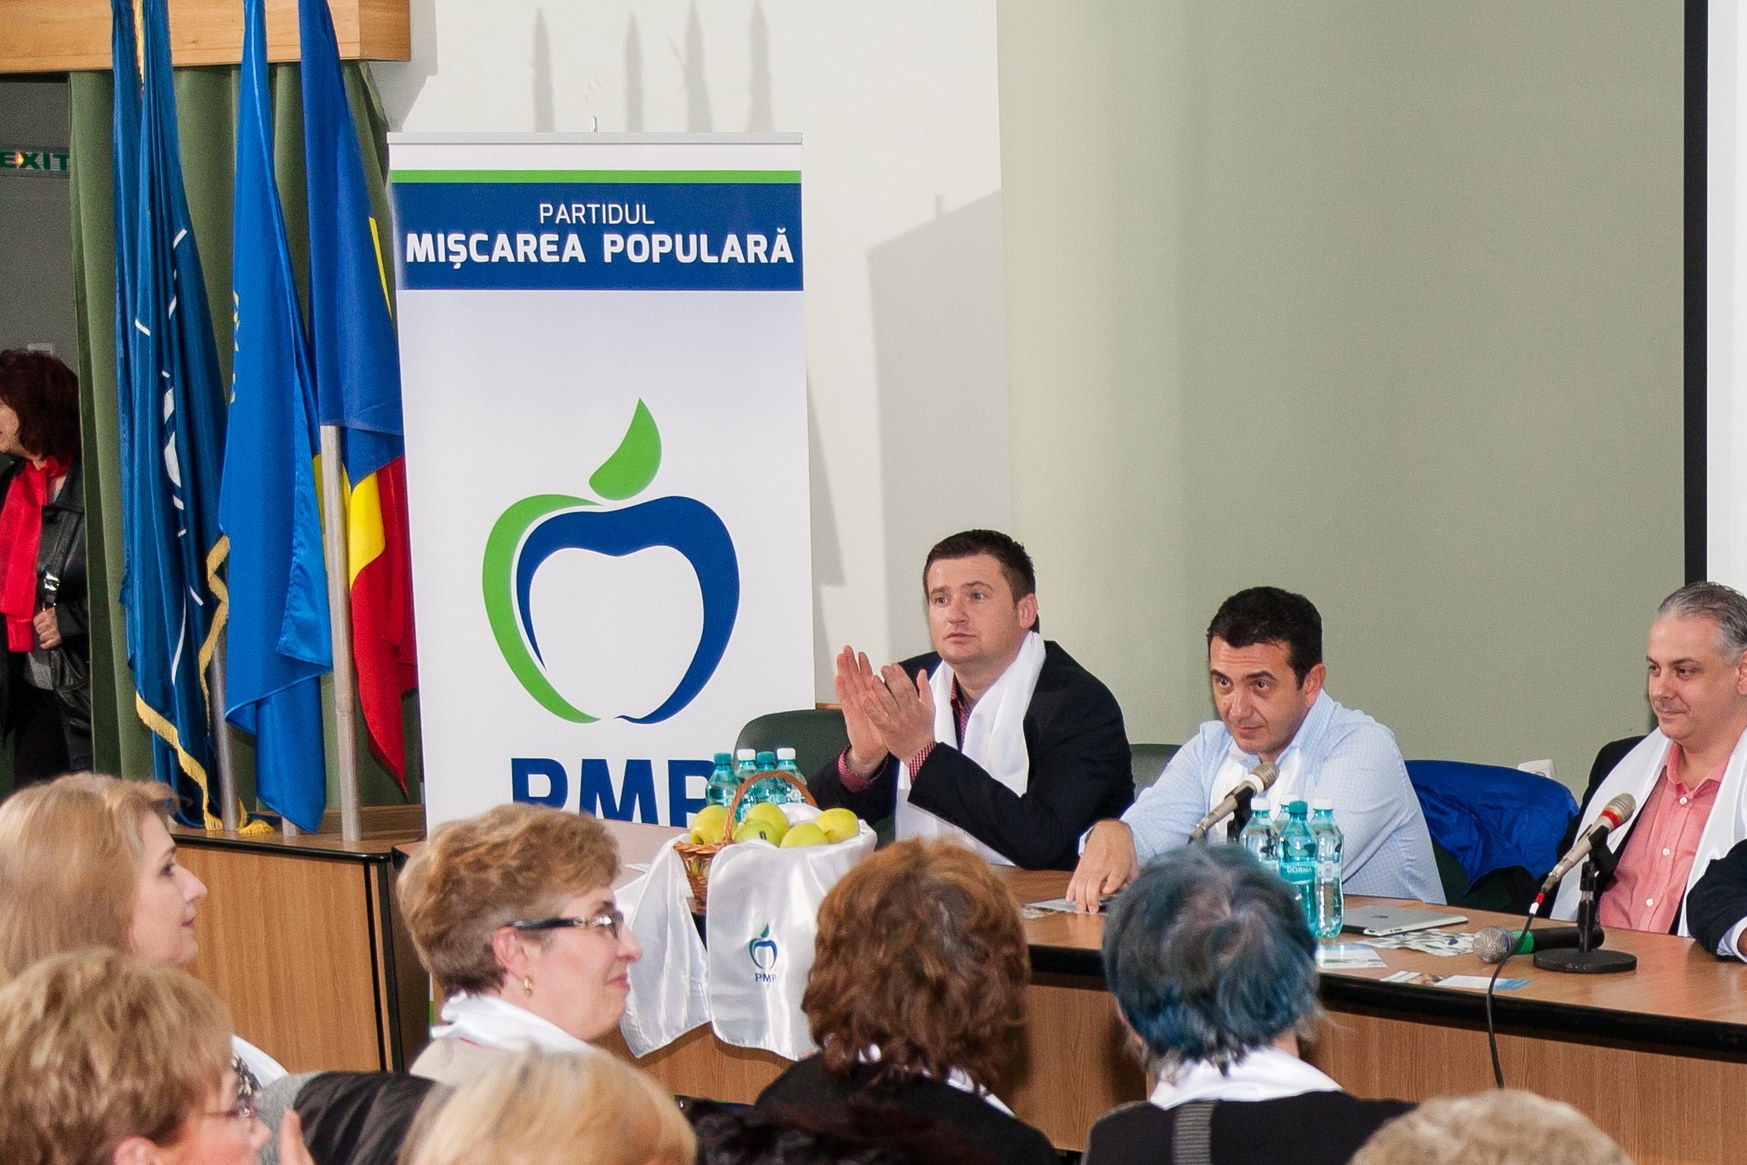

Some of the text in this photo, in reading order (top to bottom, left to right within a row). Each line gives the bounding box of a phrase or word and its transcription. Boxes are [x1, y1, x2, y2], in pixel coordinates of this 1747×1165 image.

[0, 152, 69, 171] EXIT
[539, 203, 655, 224] PARTIDUL
[603, 228, 794, 263] POPULARĂ
[510, 757, 718, 829] PMP
[754, 972, 777, 983] PMP
